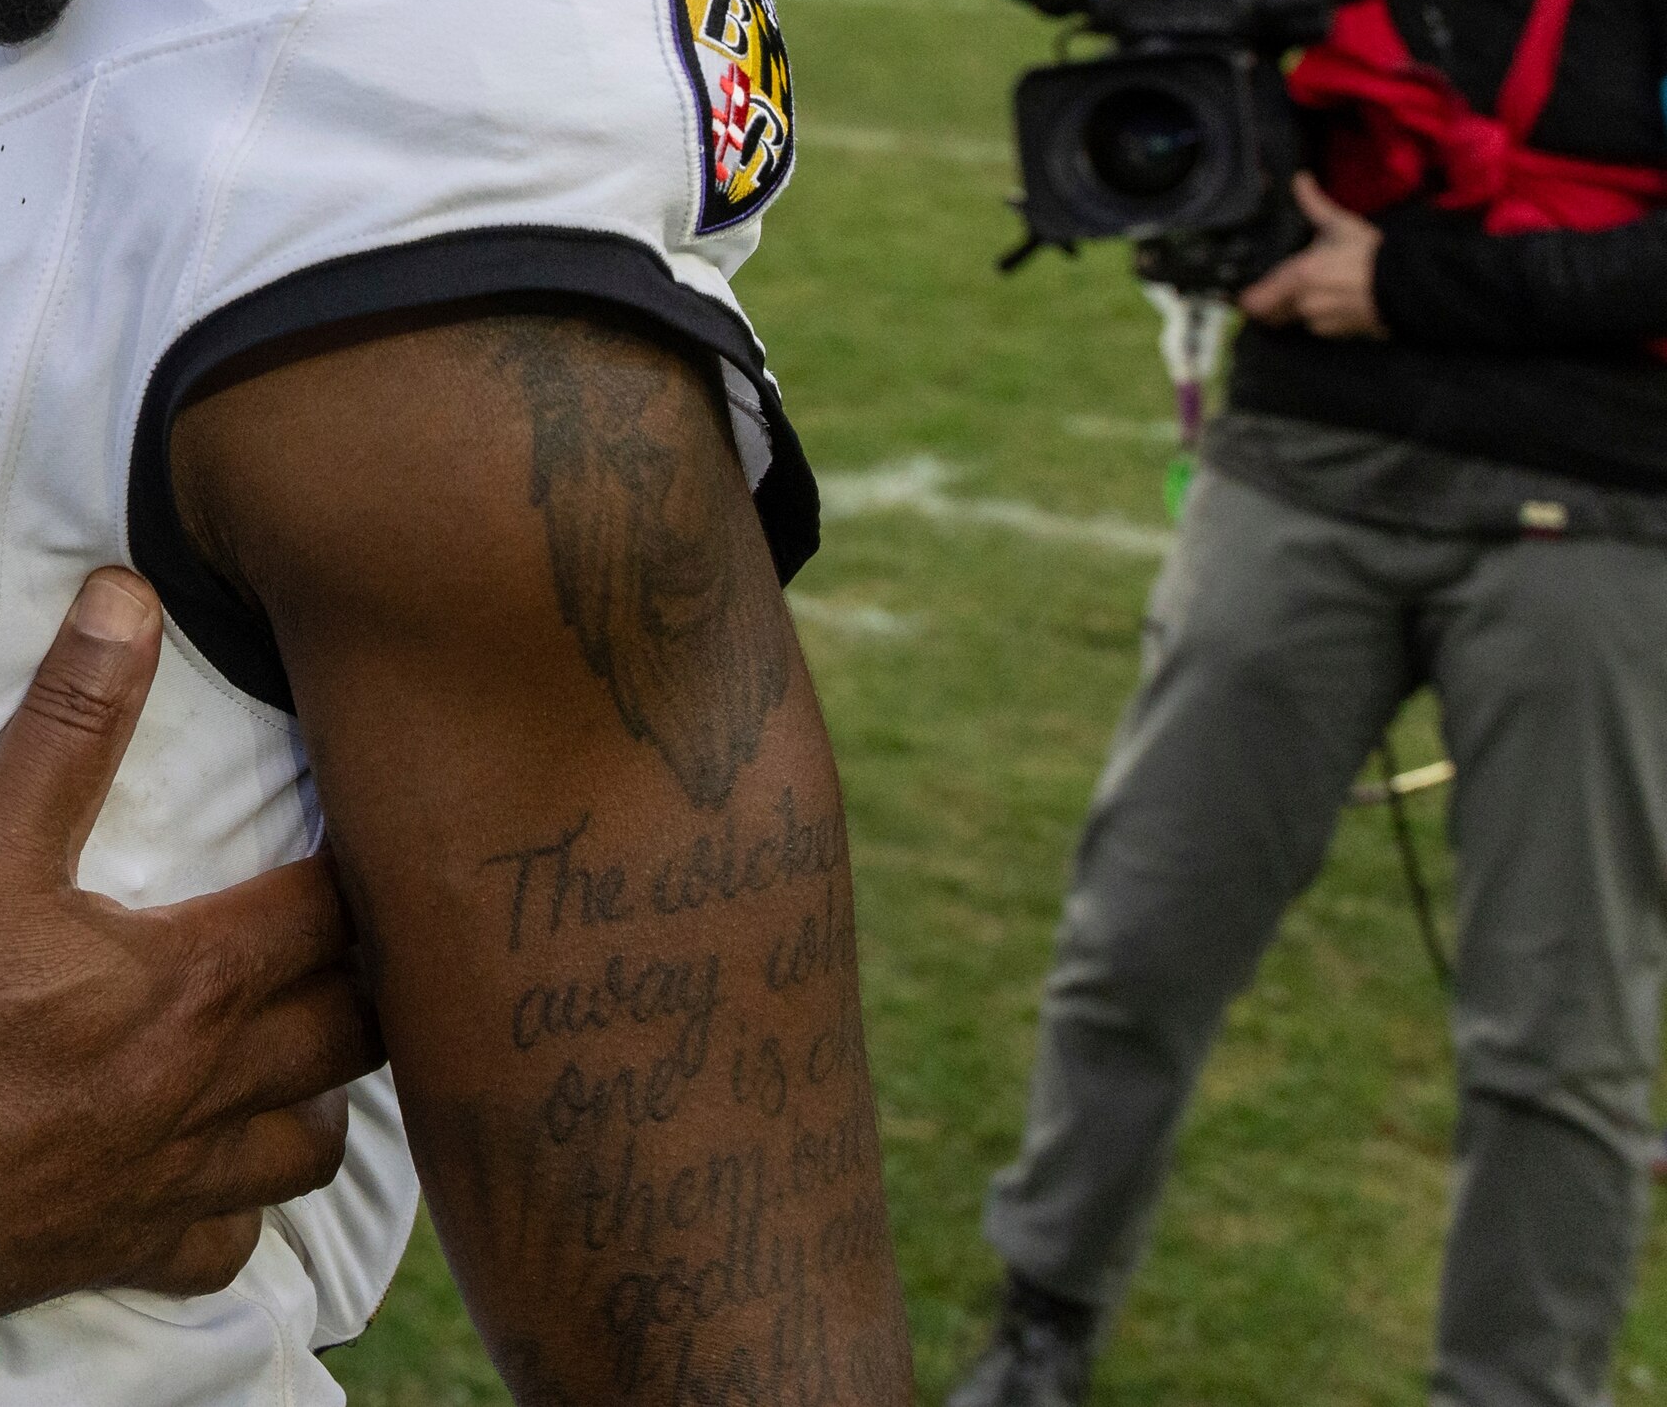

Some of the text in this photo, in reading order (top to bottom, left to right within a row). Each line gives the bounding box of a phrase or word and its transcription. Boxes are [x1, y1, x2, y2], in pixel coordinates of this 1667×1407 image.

[479, 810, 635, 954] The
[511, 952, 725, 1080] away
[545, 1052, 684, 1148] one
